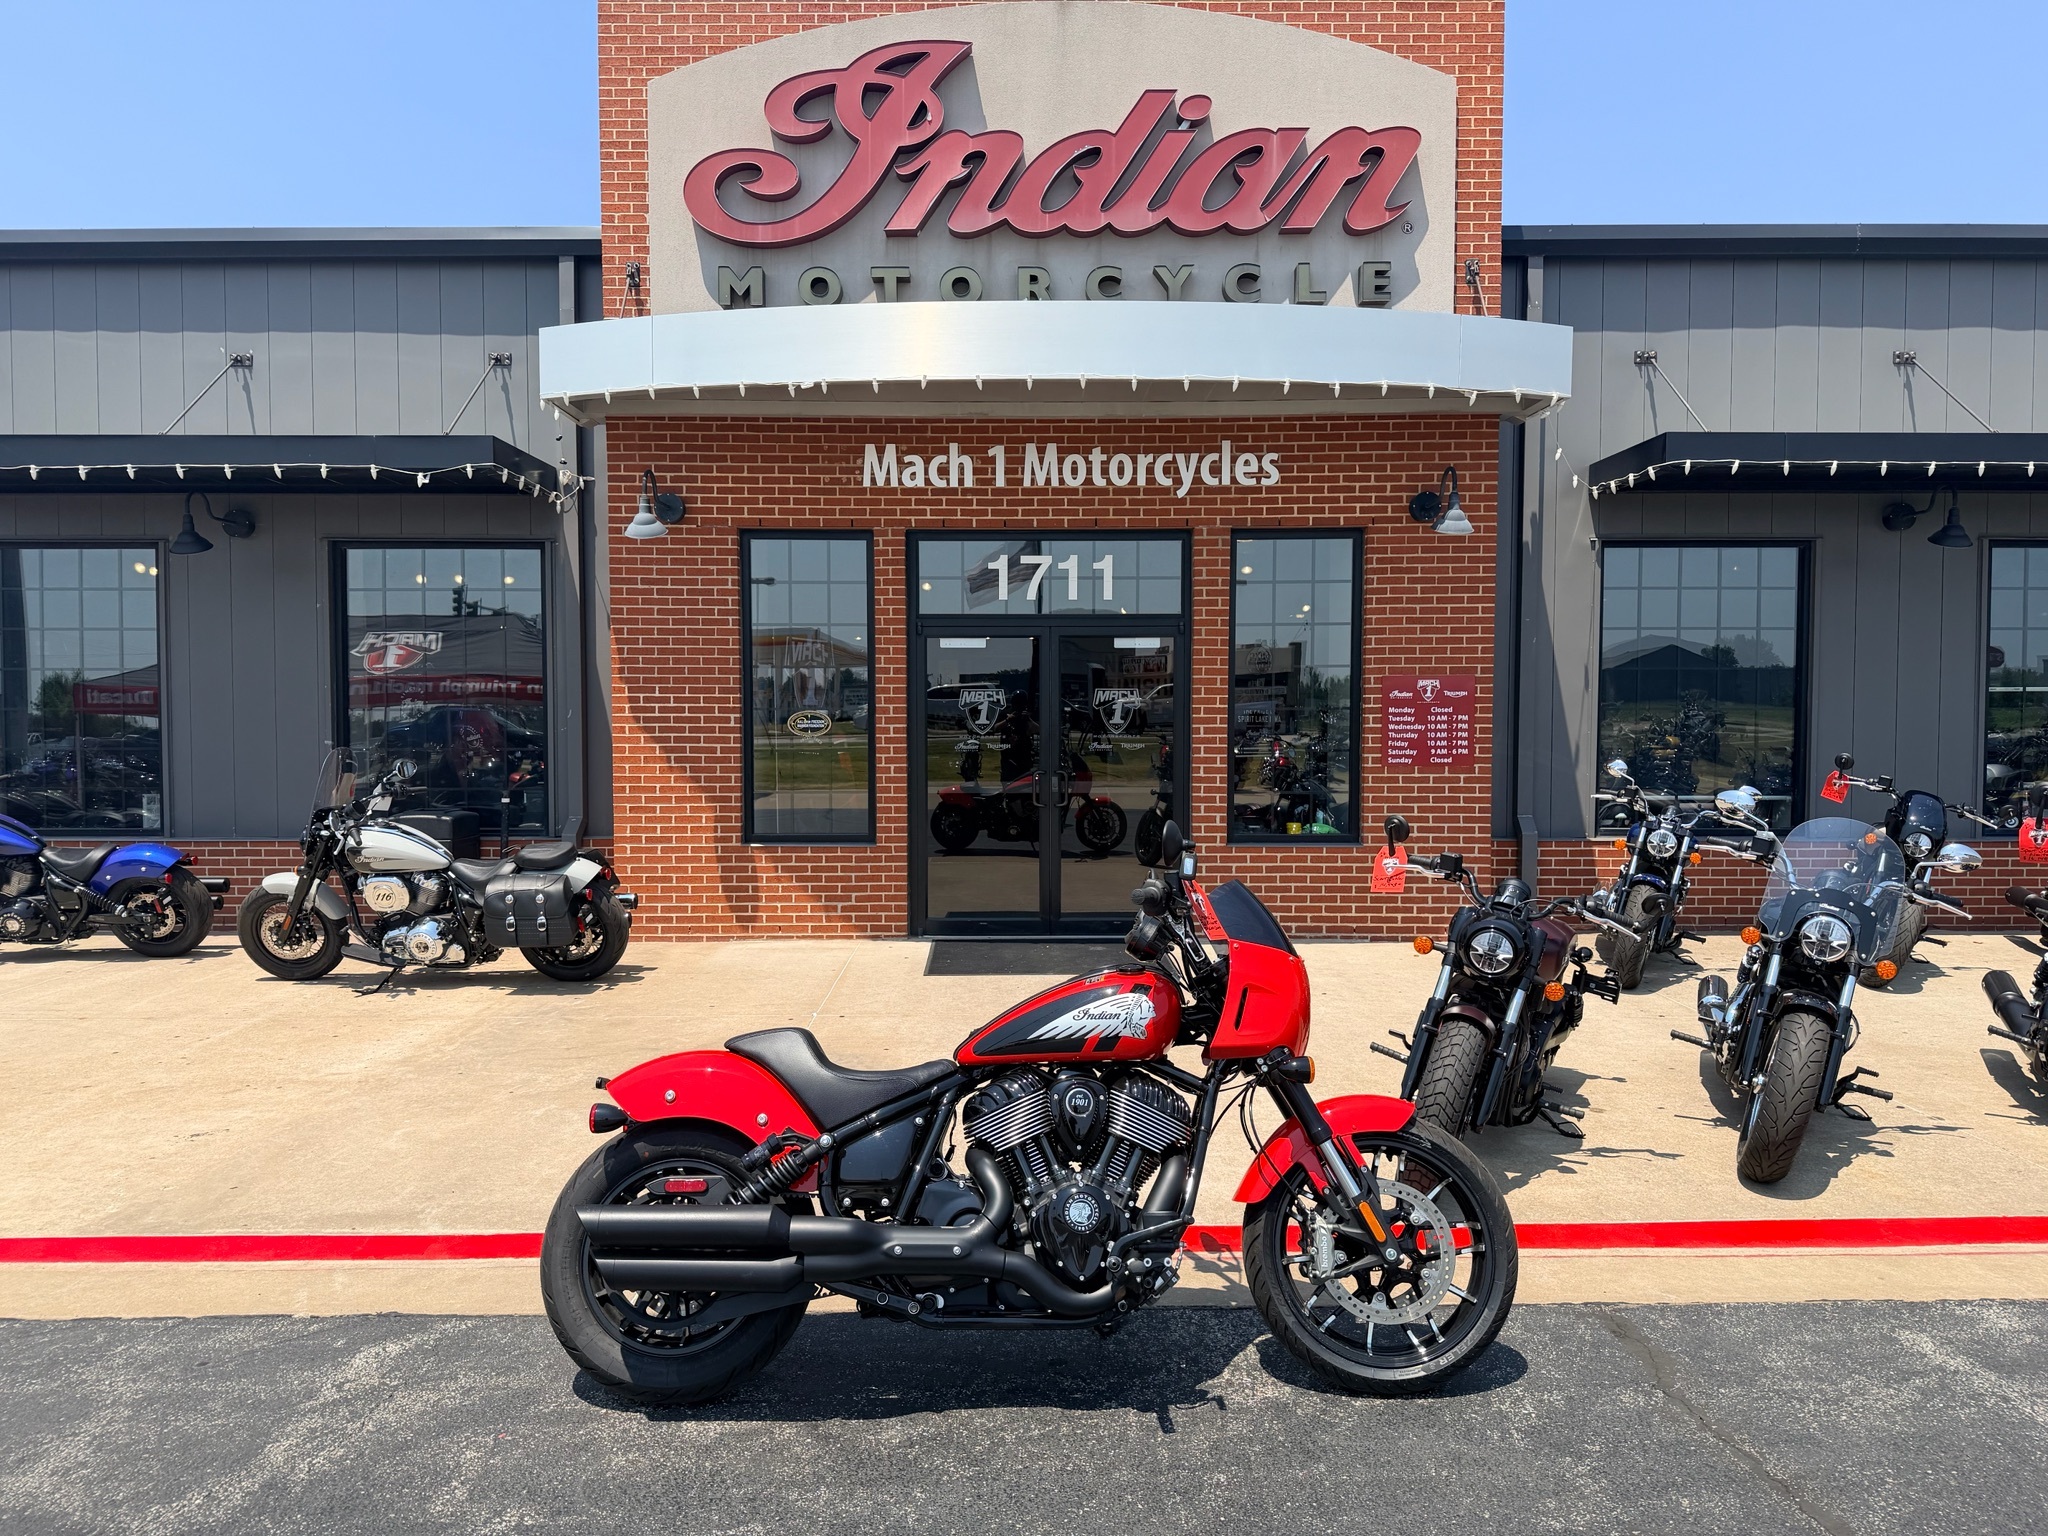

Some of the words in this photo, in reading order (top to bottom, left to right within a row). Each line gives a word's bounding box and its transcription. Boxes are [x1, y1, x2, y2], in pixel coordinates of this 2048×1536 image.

[683, 40, 1422, 248] Indian
[717, 261, 1393, 308] MOTORCYCLE
[863, 443, 974, 488] Mach
[987, 445, 1005, 488] 1
[1023, 440, 1280, 498] Motorcycles
[987, 554, 1113, 600] 1711
[961, 691, 1005, 706] MACH
[1095, 690, 1139, 705] MACH
[974, 700, 991, 725] 1
[1109, 701, 1124, 724] 1
[354, 855, 385, 863] Indian
[375, 892, 394, 901] 116
[1072, 1007, 1122, 1021] Indian
[1071, 1098, 1089, 1106] 1901
[1064, 1199, 1074, 1224] INDIAN
[1074, 1194, 1100, 1225] MOTORCYCLE
[1320, 1236, 1329, 1267] brembo
[1438, 1313, 1494, 1366] METZELER
